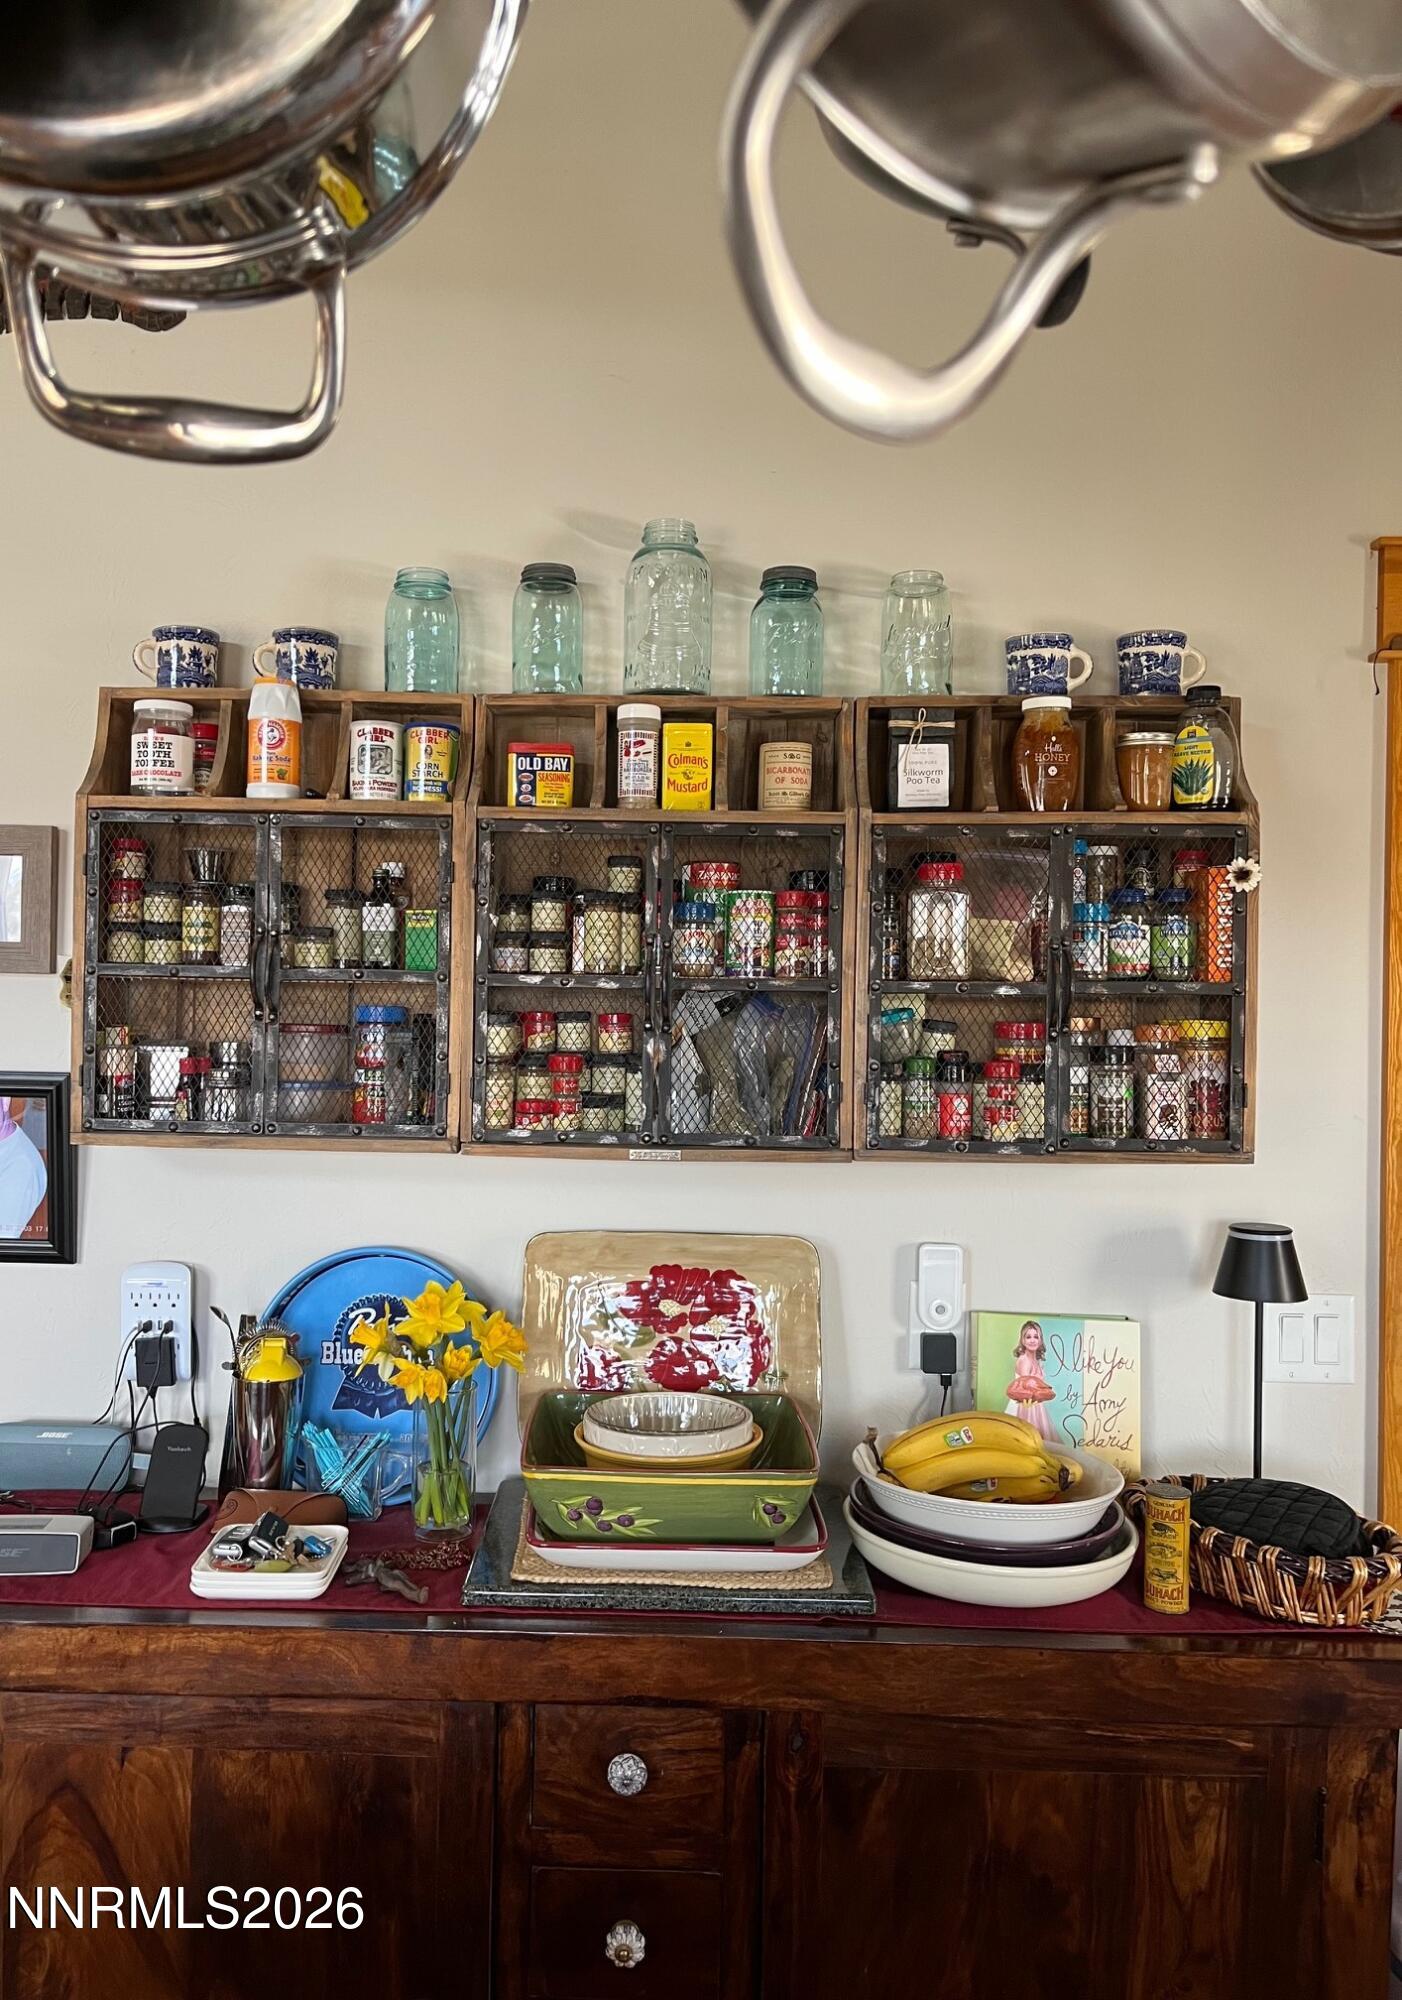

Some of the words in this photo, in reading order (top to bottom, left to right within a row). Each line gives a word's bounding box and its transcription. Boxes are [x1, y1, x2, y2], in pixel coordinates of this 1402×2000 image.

[357, 728, 394, 740] CLBBER
[410, 728, 448, 740] CLBBER
[668, 753, 708, 770] Colman's
[1034, 752, 1070, 762] HONEY
[518, 756, 542, 770] OLD
[544, 756, 568, 771] BAY
[766, 766, 810, 775] BICARBONAT
[904, 768, 944, 776] Silkworm
[538, 772, 570, 783] SEASONING
[775, 776, 785, 784] OF
[790, 776, 808, 784] SODA
[906, 776, 922, 784] Poo
[925, 776, 941, 784] Tea
[372, 780, 398, 788] POWDER
[667, 778, 708, 793] Mustard
[321, 1341, 364, 1365] Blue
[1050, 1334, 1070, 1378] I
[1072, 1332, 1104, 1374] like
[1104, 1346, 1136, 1388] You
[1061, 1384, 1083, 1409] by
[1082, 1382, 1127, 1432] Amy
[1062, 1414, 1134, 1451] Sedaris
[0, 1548, 30, 1558] SE
